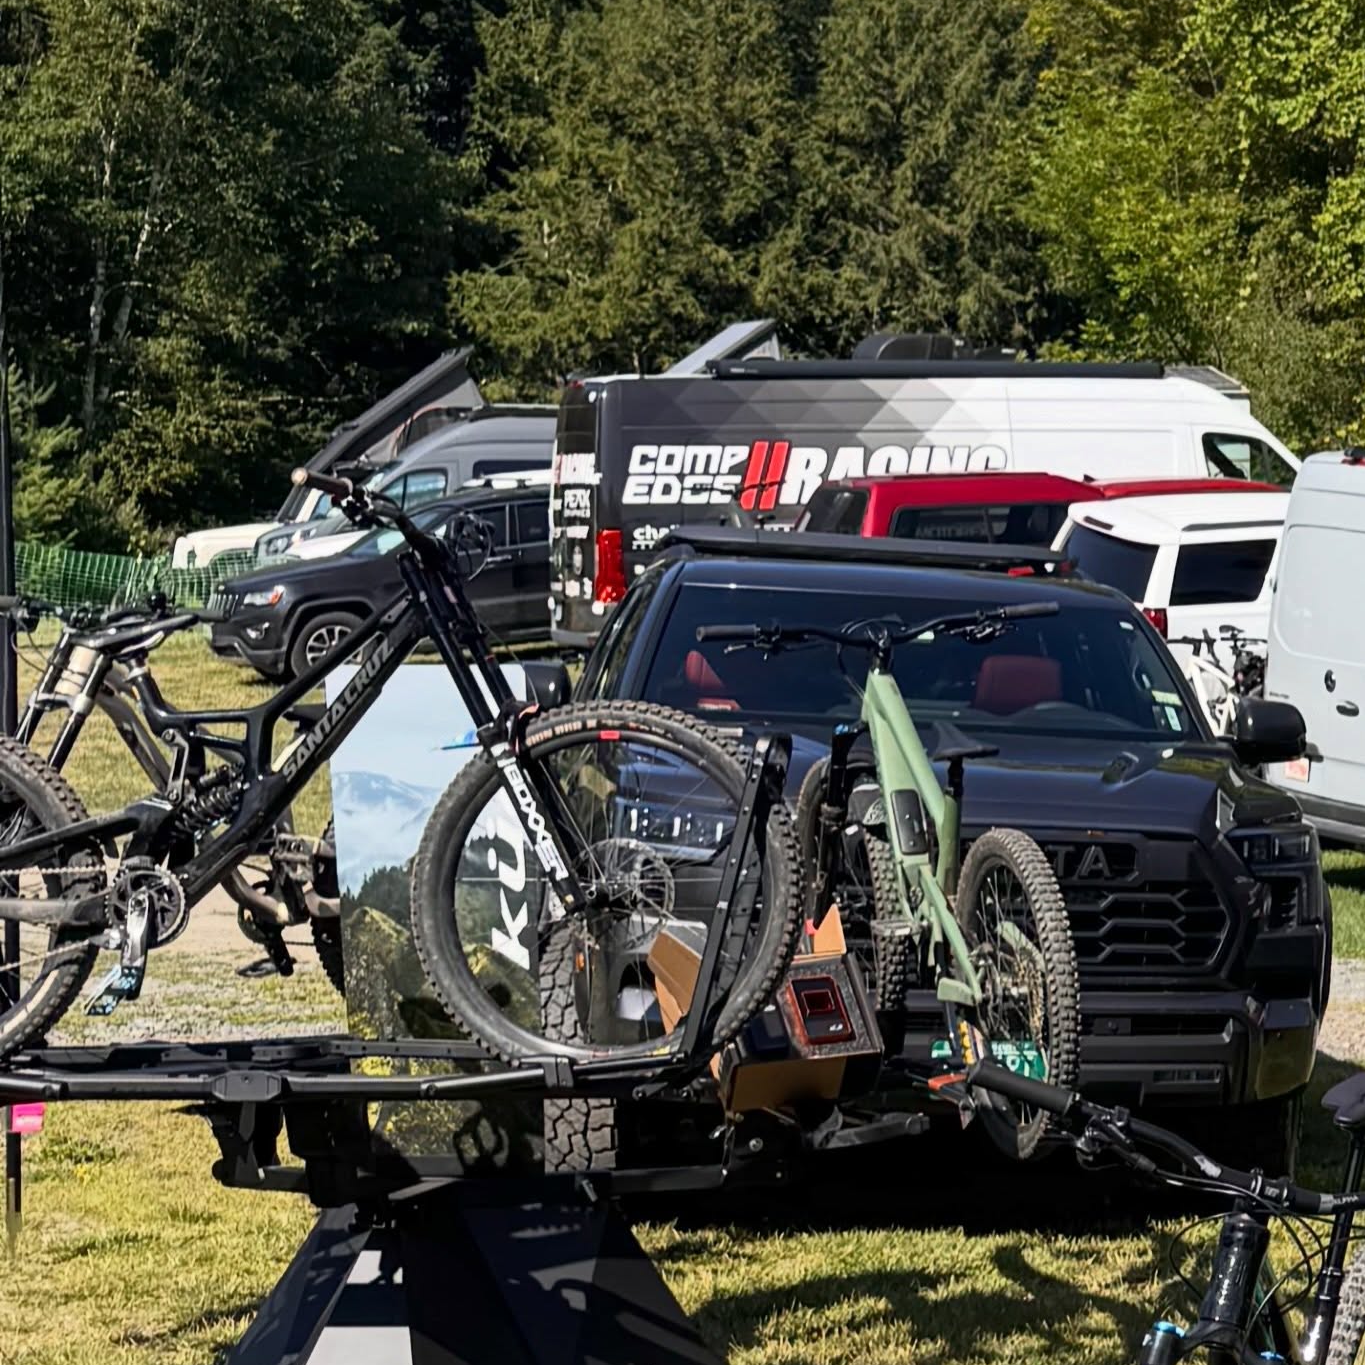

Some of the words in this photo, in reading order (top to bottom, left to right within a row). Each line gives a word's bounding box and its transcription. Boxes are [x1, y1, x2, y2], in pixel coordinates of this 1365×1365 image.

[628, 445, 749, 474] COMP
[284, 701, 347, 782] SANTA
[341, 643, 396, 710] CRUZ
[502, 762, 571, 881] BOXXER
